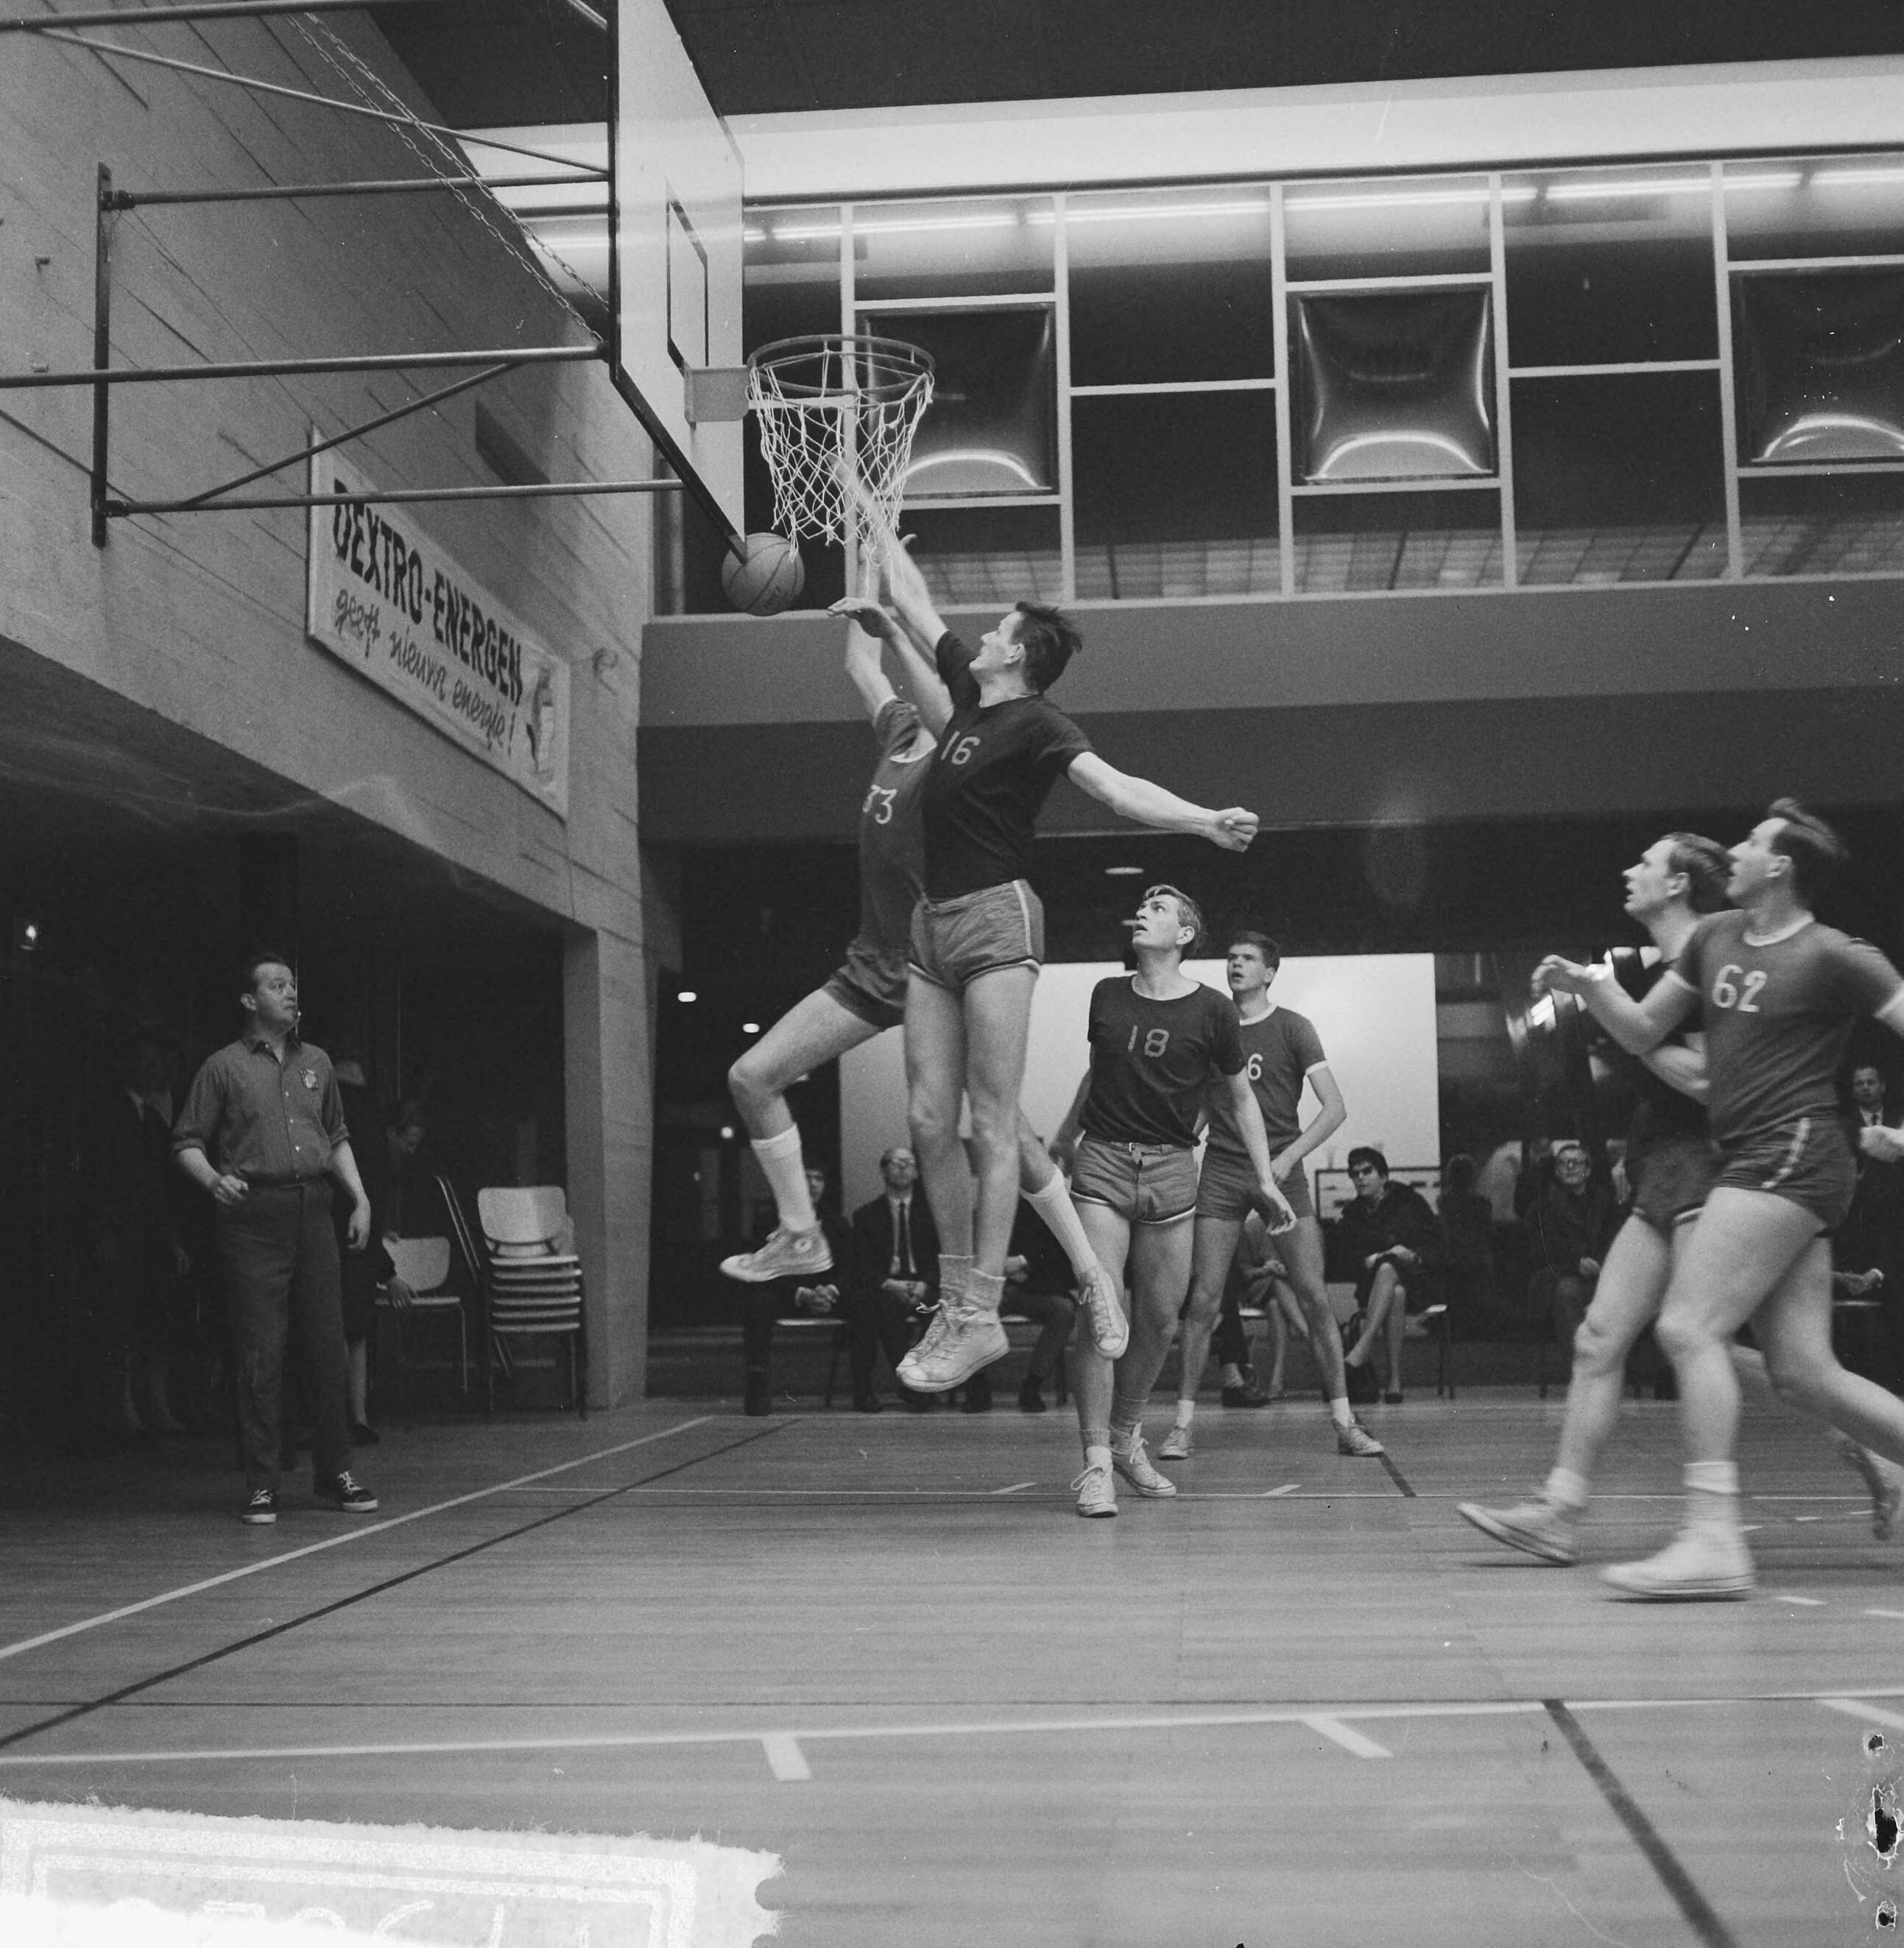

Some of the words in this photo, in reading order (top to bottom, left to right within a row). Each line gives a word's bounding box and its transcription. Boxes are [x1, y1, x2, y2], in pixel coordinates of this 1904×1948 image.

[333, 478, 523, 707] DEXTRO-ENERGEN
[334, 588, 381, 657] geeft
[940, 731, 981, 765] 16
[1711, 964, 1768, 1013] 62
[1127, 1025, 1170, 1058] 18
